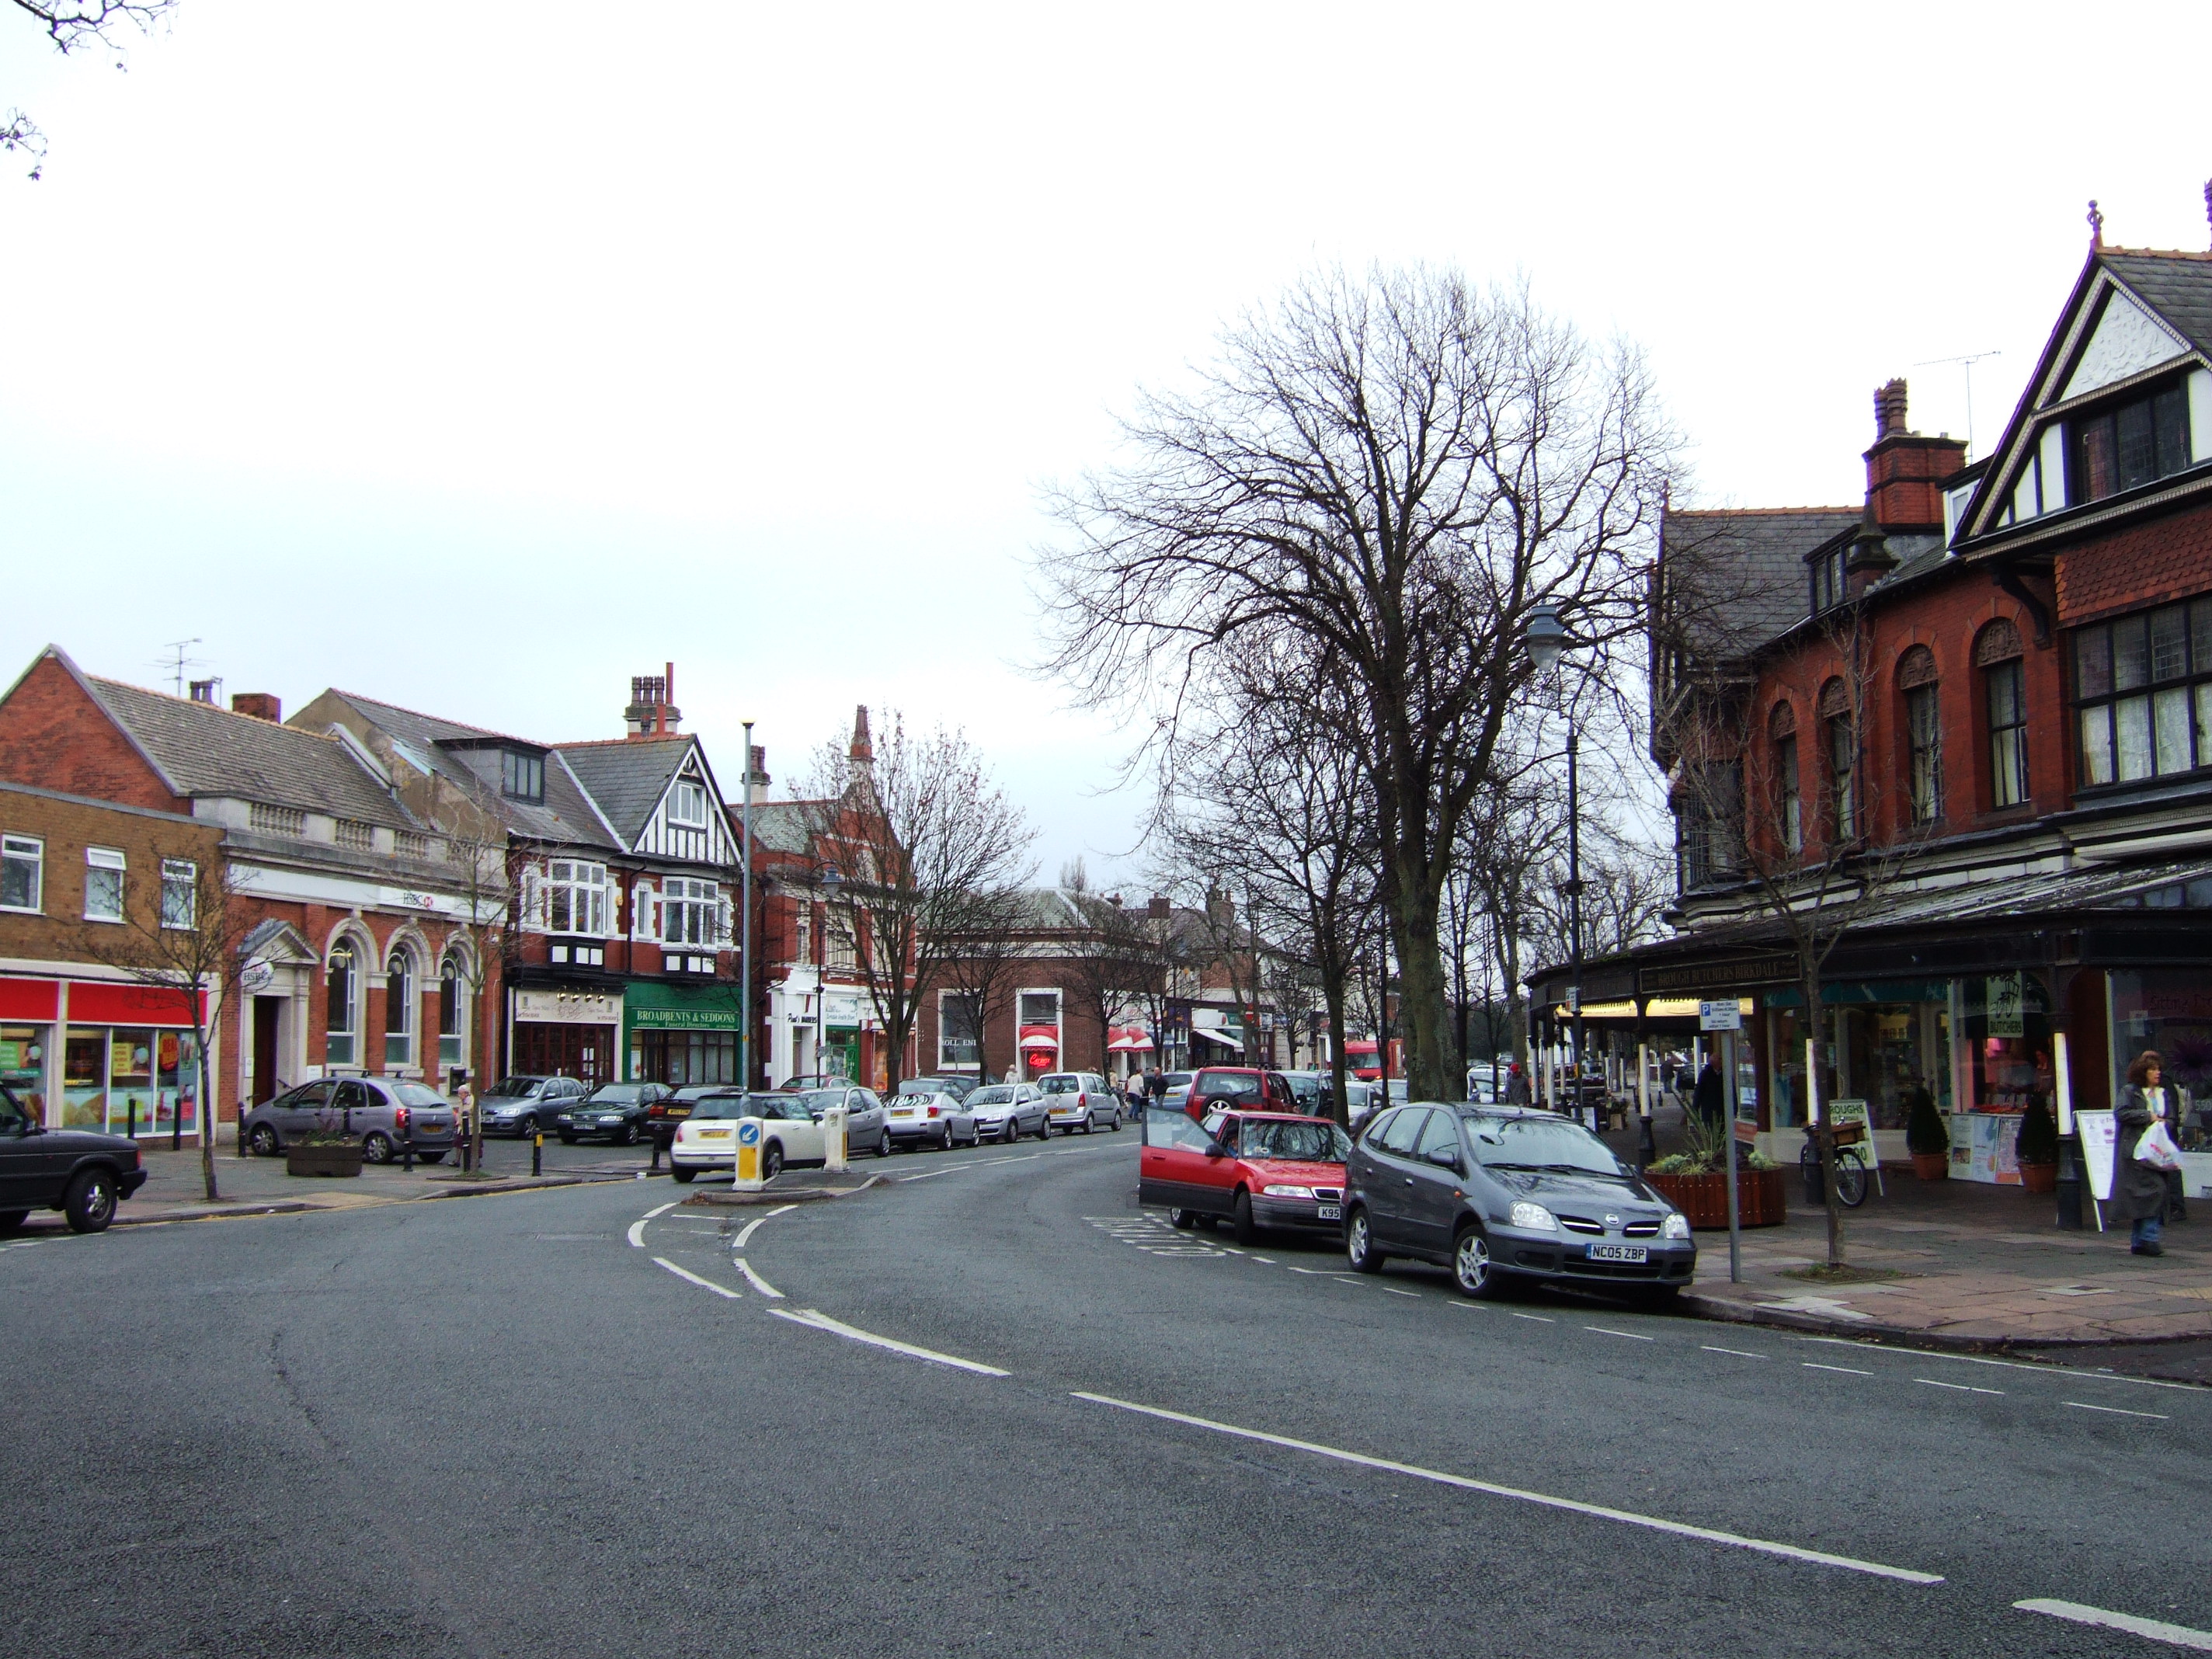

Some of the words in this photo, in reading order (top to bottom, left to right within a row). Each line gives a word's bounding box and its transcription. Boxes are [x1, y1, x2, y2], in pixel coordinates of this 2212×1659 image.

[403, 892, 423, 906] HSBC
[1657, 970, 1690, 987] BROUGH
[1692, 966, 1734, 984] BUTCHERS
[1735, 962, 1778, 979] BIRKDALE
[637, 1010, 690, 1022] BROADBENTS
[692, 1012, 699, 1022] &
[700, 1013, 736, 1024] SEDDONS
[1989, 1020, 2022, 1034] BUTCHERS
[1829, 1104, 1864, 1115] ROUGHS
[1592, 1246, 1622, 1258] NC05
[1624, 1247, 1645, 1260] ZBP
